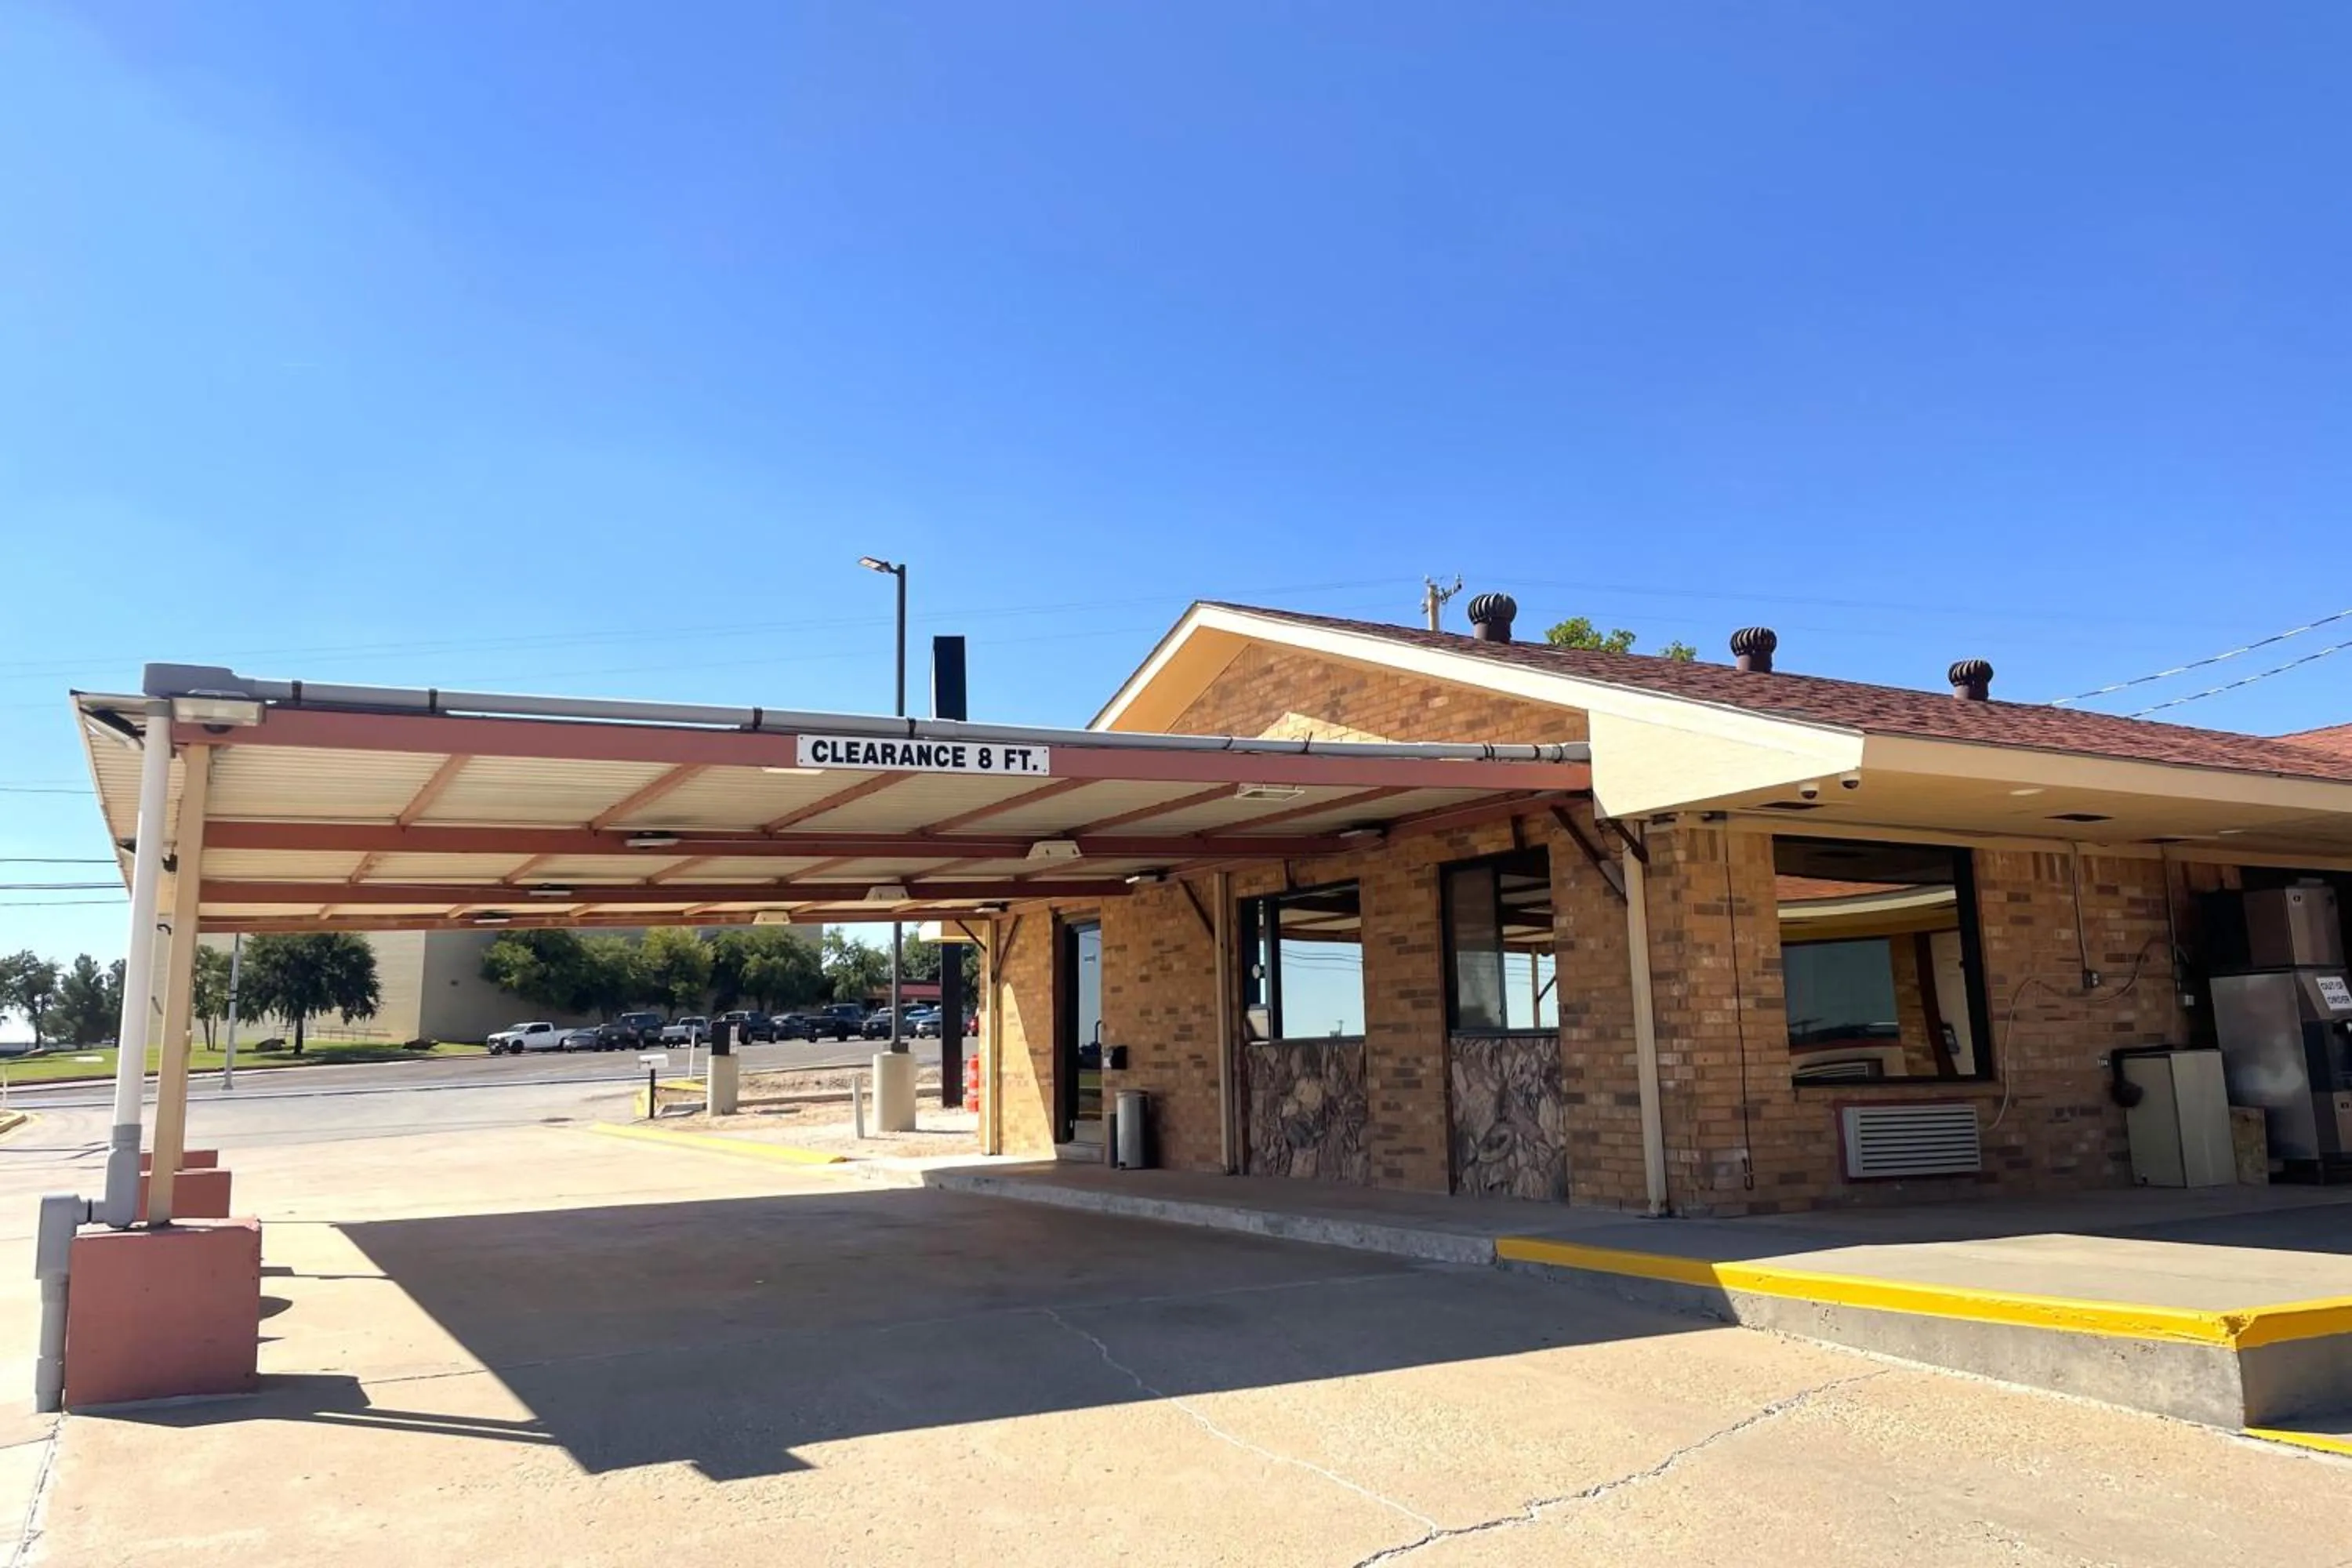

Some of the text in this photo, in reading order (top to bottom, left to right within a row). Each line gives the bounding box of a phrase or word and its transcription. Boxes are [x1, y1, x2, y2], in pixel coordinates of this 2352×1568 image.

[811, 740, 1038, 771] CLEARANCE 8 FT.
